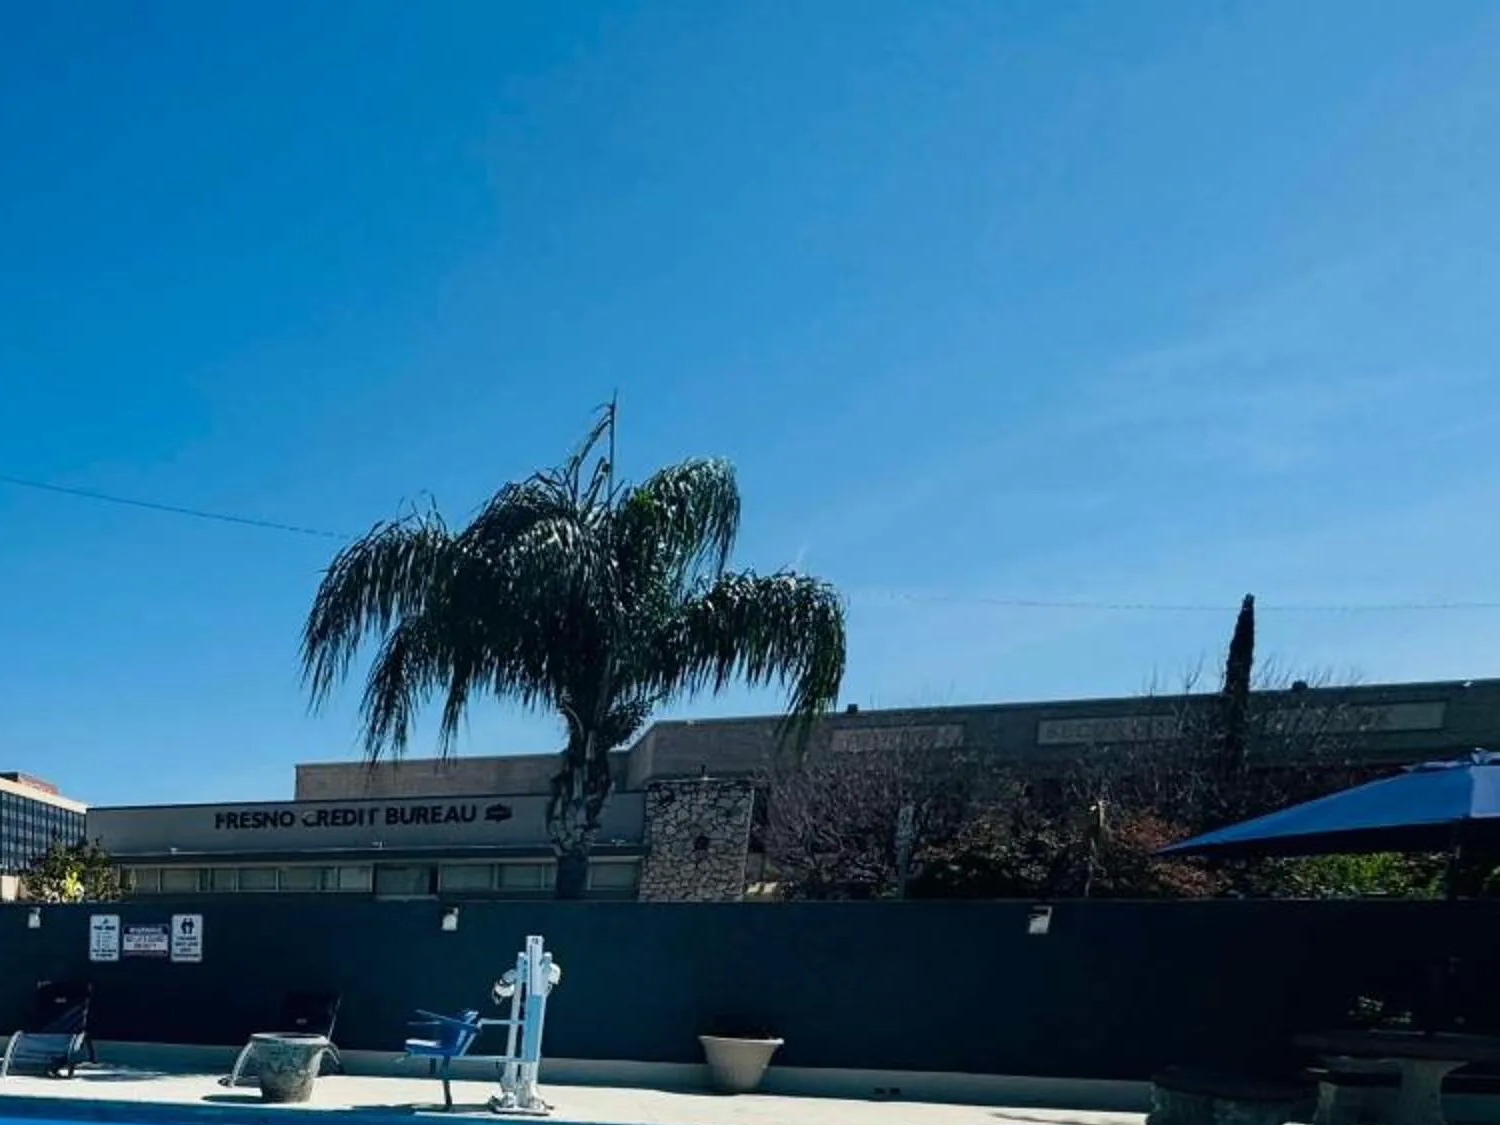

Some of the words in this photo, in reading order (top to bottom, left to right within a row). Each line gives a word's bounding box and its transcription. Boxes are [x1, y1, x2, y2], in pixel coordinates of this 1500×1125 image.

[214, 809, 296, 830] FRESNO
[301, 807, 381, 827] CREDIT
[385, 804, 477, 826] BUREAU
